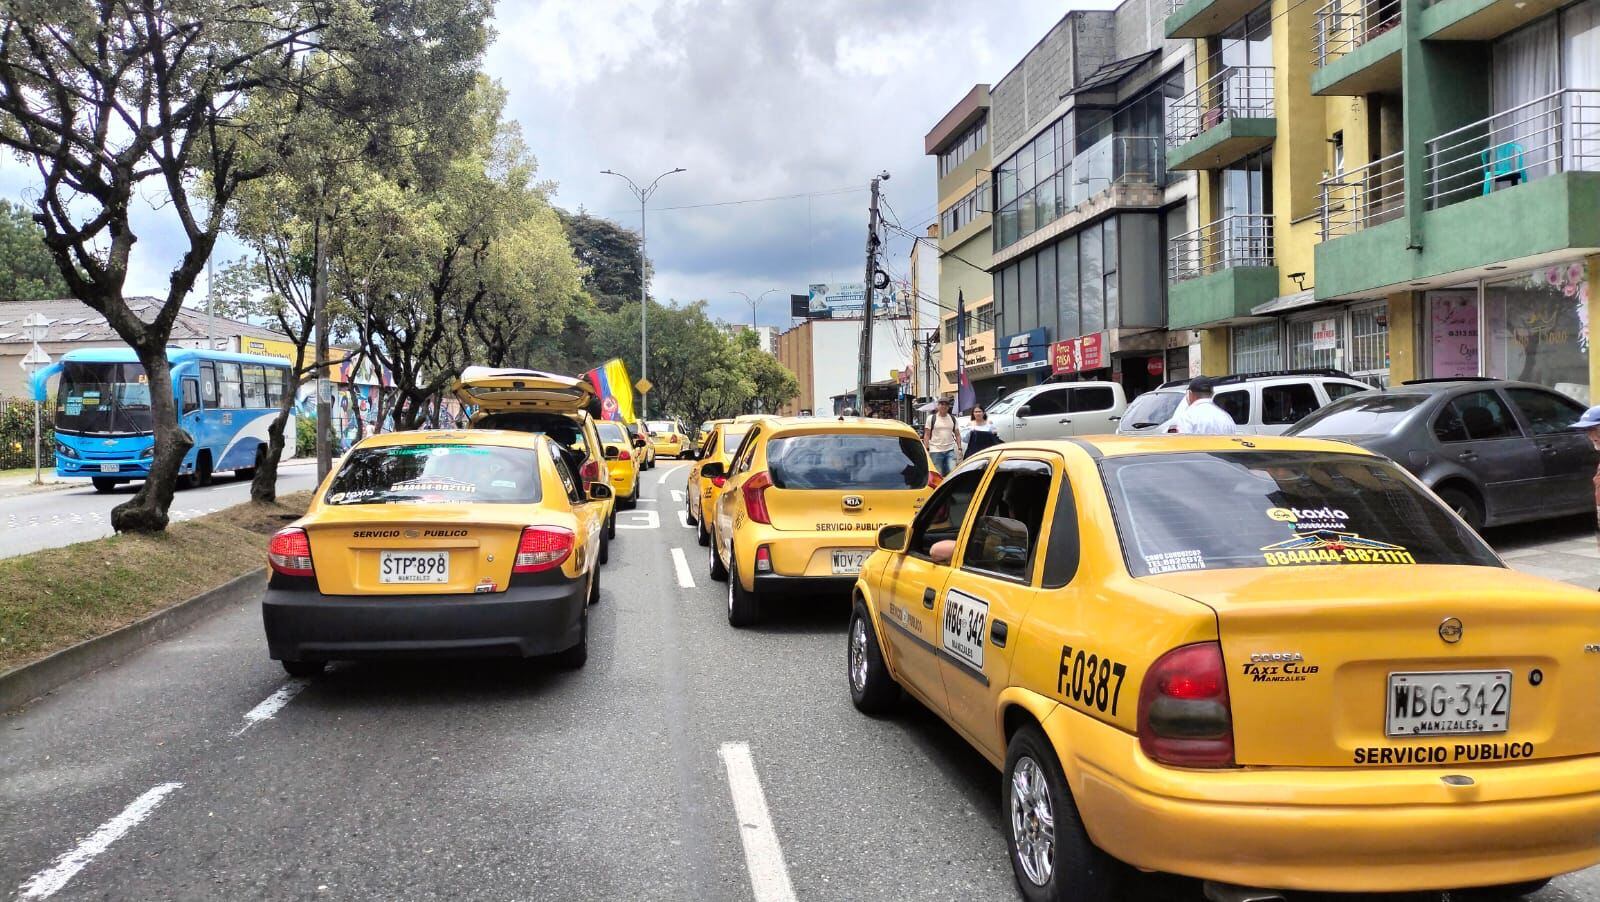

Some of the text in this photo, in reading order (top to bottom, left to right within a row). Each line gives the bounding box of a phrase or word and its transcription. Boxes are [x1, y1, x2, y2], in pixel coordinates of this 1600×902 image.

[816, 523, 853, 531] SERVICIO
[1264, 549, 1416, 566] 8844444-8821111
[1250, 652, 1305, 662] CORSA
[1057, 645, 1127, 716] F.0387
[1420, 720, 1479, 732] MANIZALES
[1353, 741, 1534, 764] SERVICIO PUBLICO
